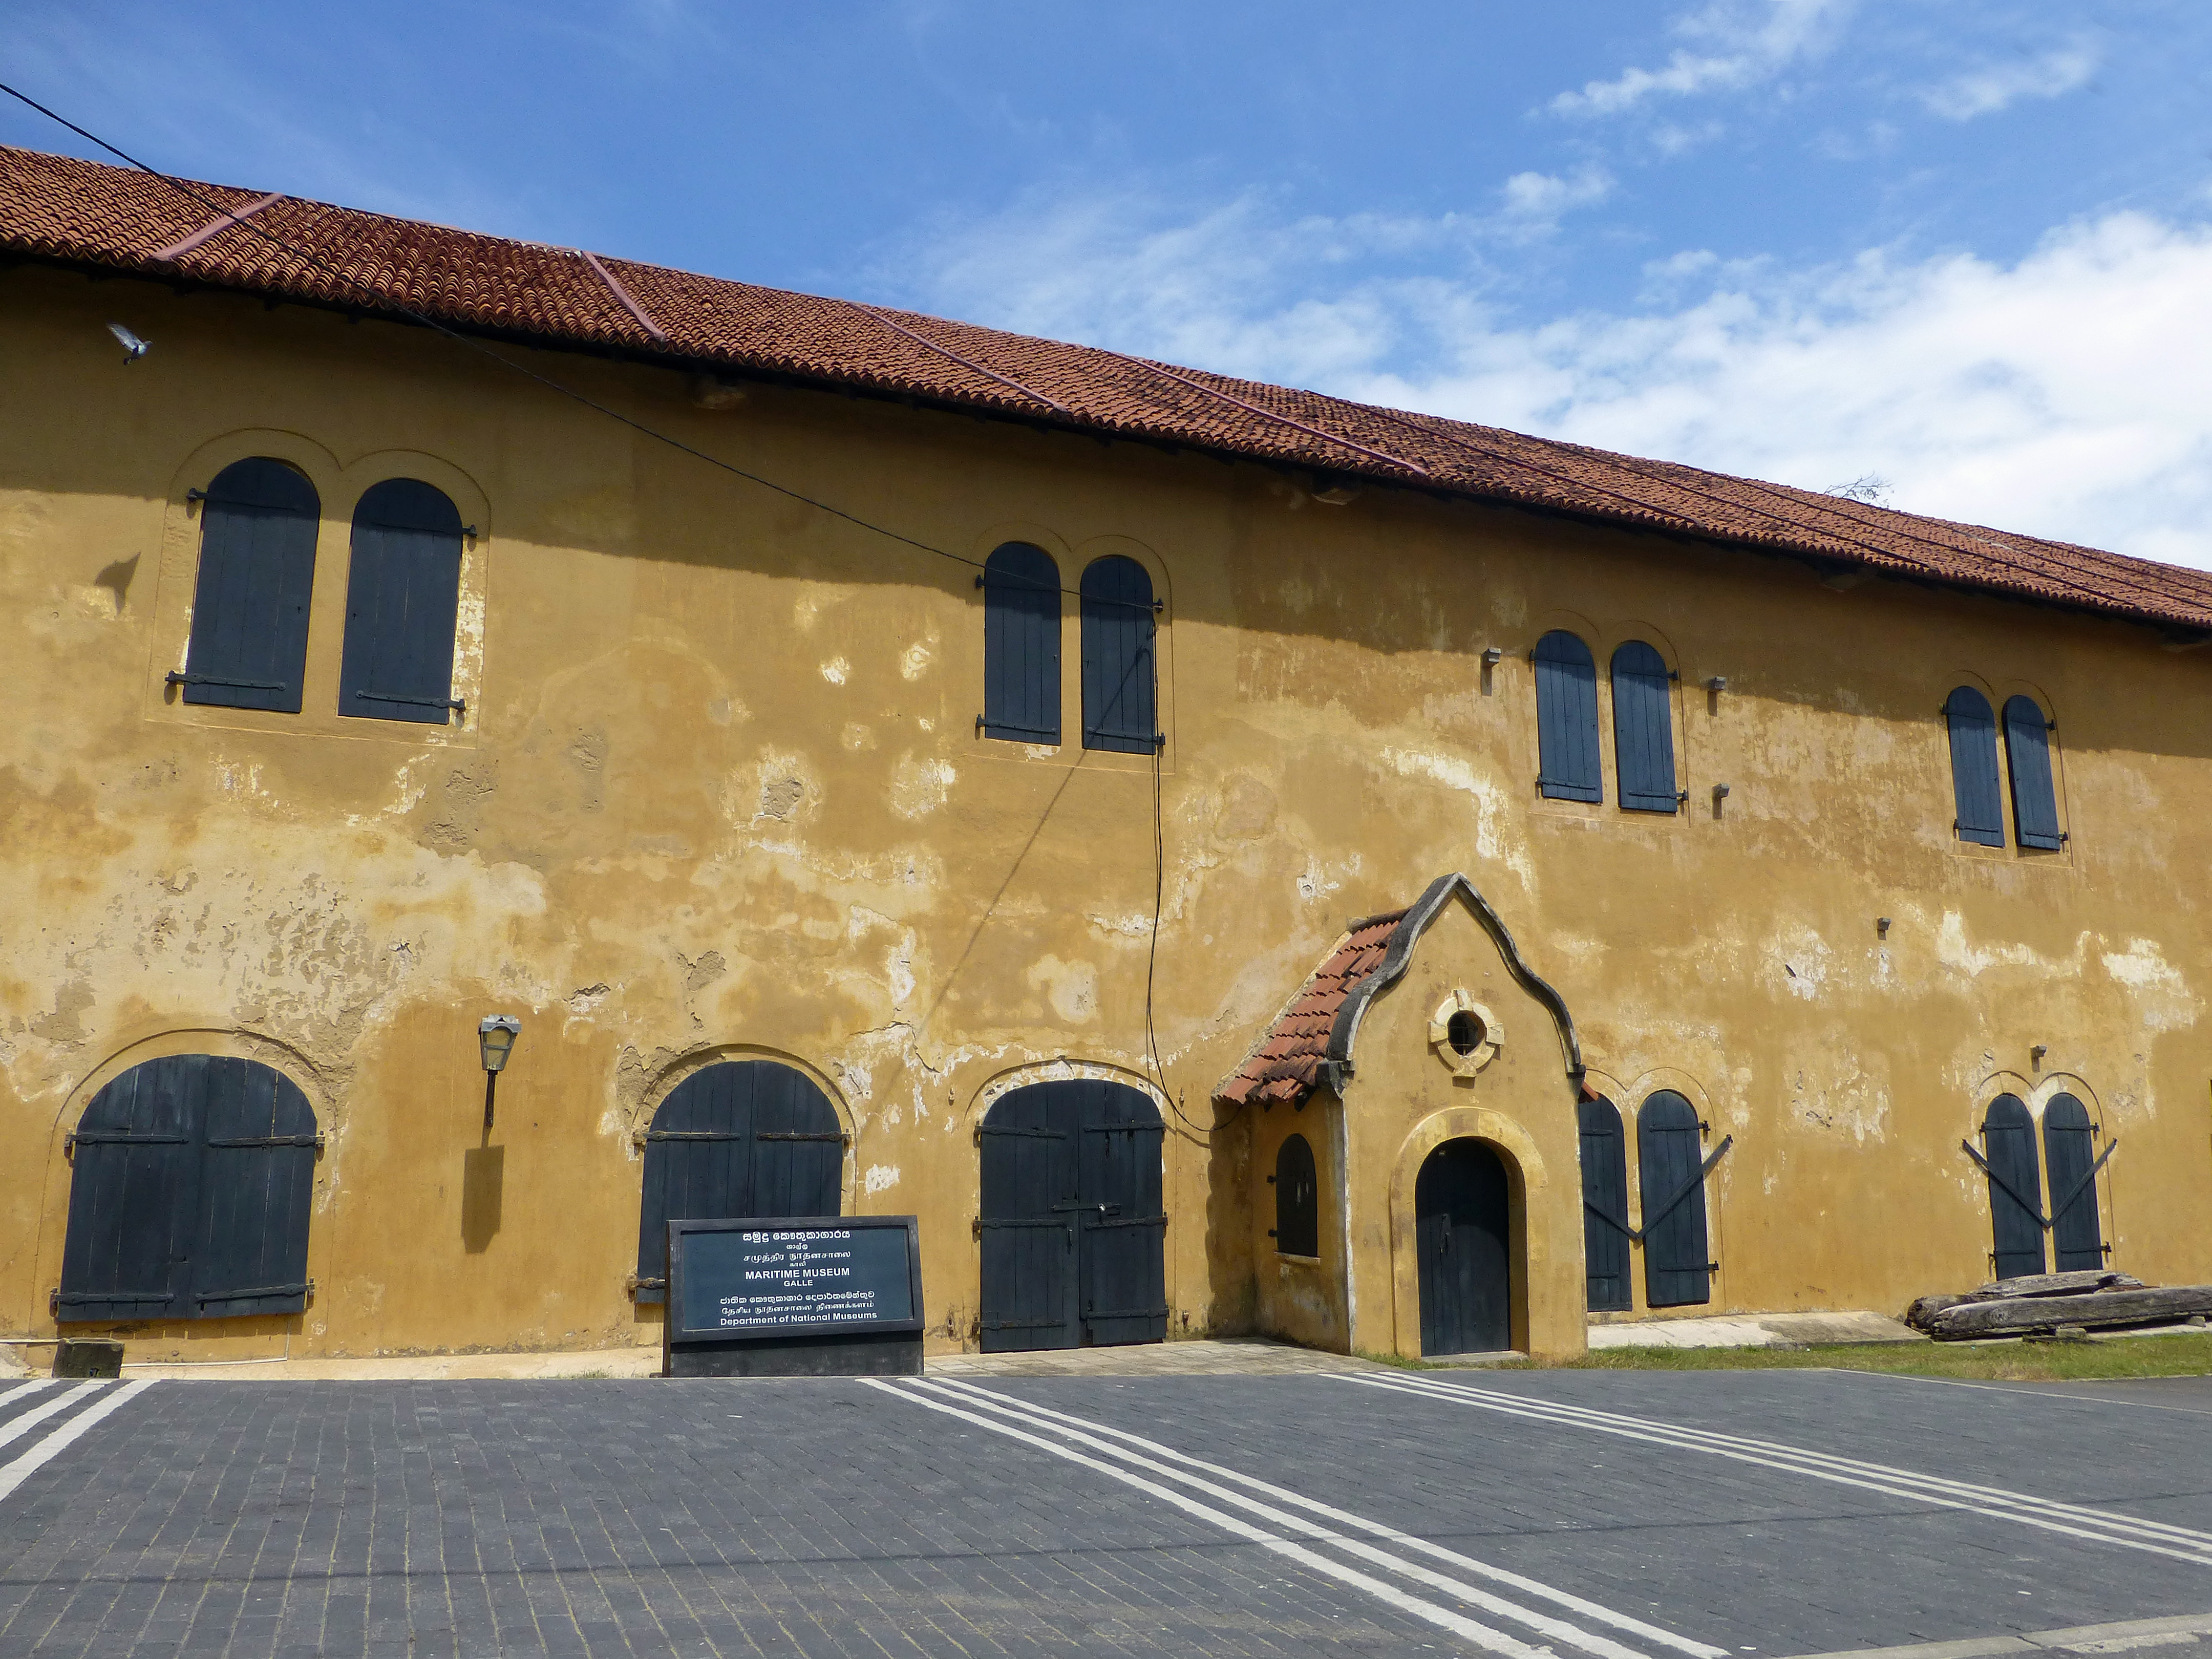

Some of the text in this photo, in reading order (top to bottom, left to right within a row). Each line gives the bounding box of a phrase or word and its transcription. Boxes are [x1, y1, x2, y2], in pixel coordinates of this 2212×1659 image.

[745, 1268, 850, 1280] MARITIME MUSEUM
[720, 1316, 777, 1326] Department
[791, 1313, 831, 1322] National
[833, 1312, 877, 1321] Museums
